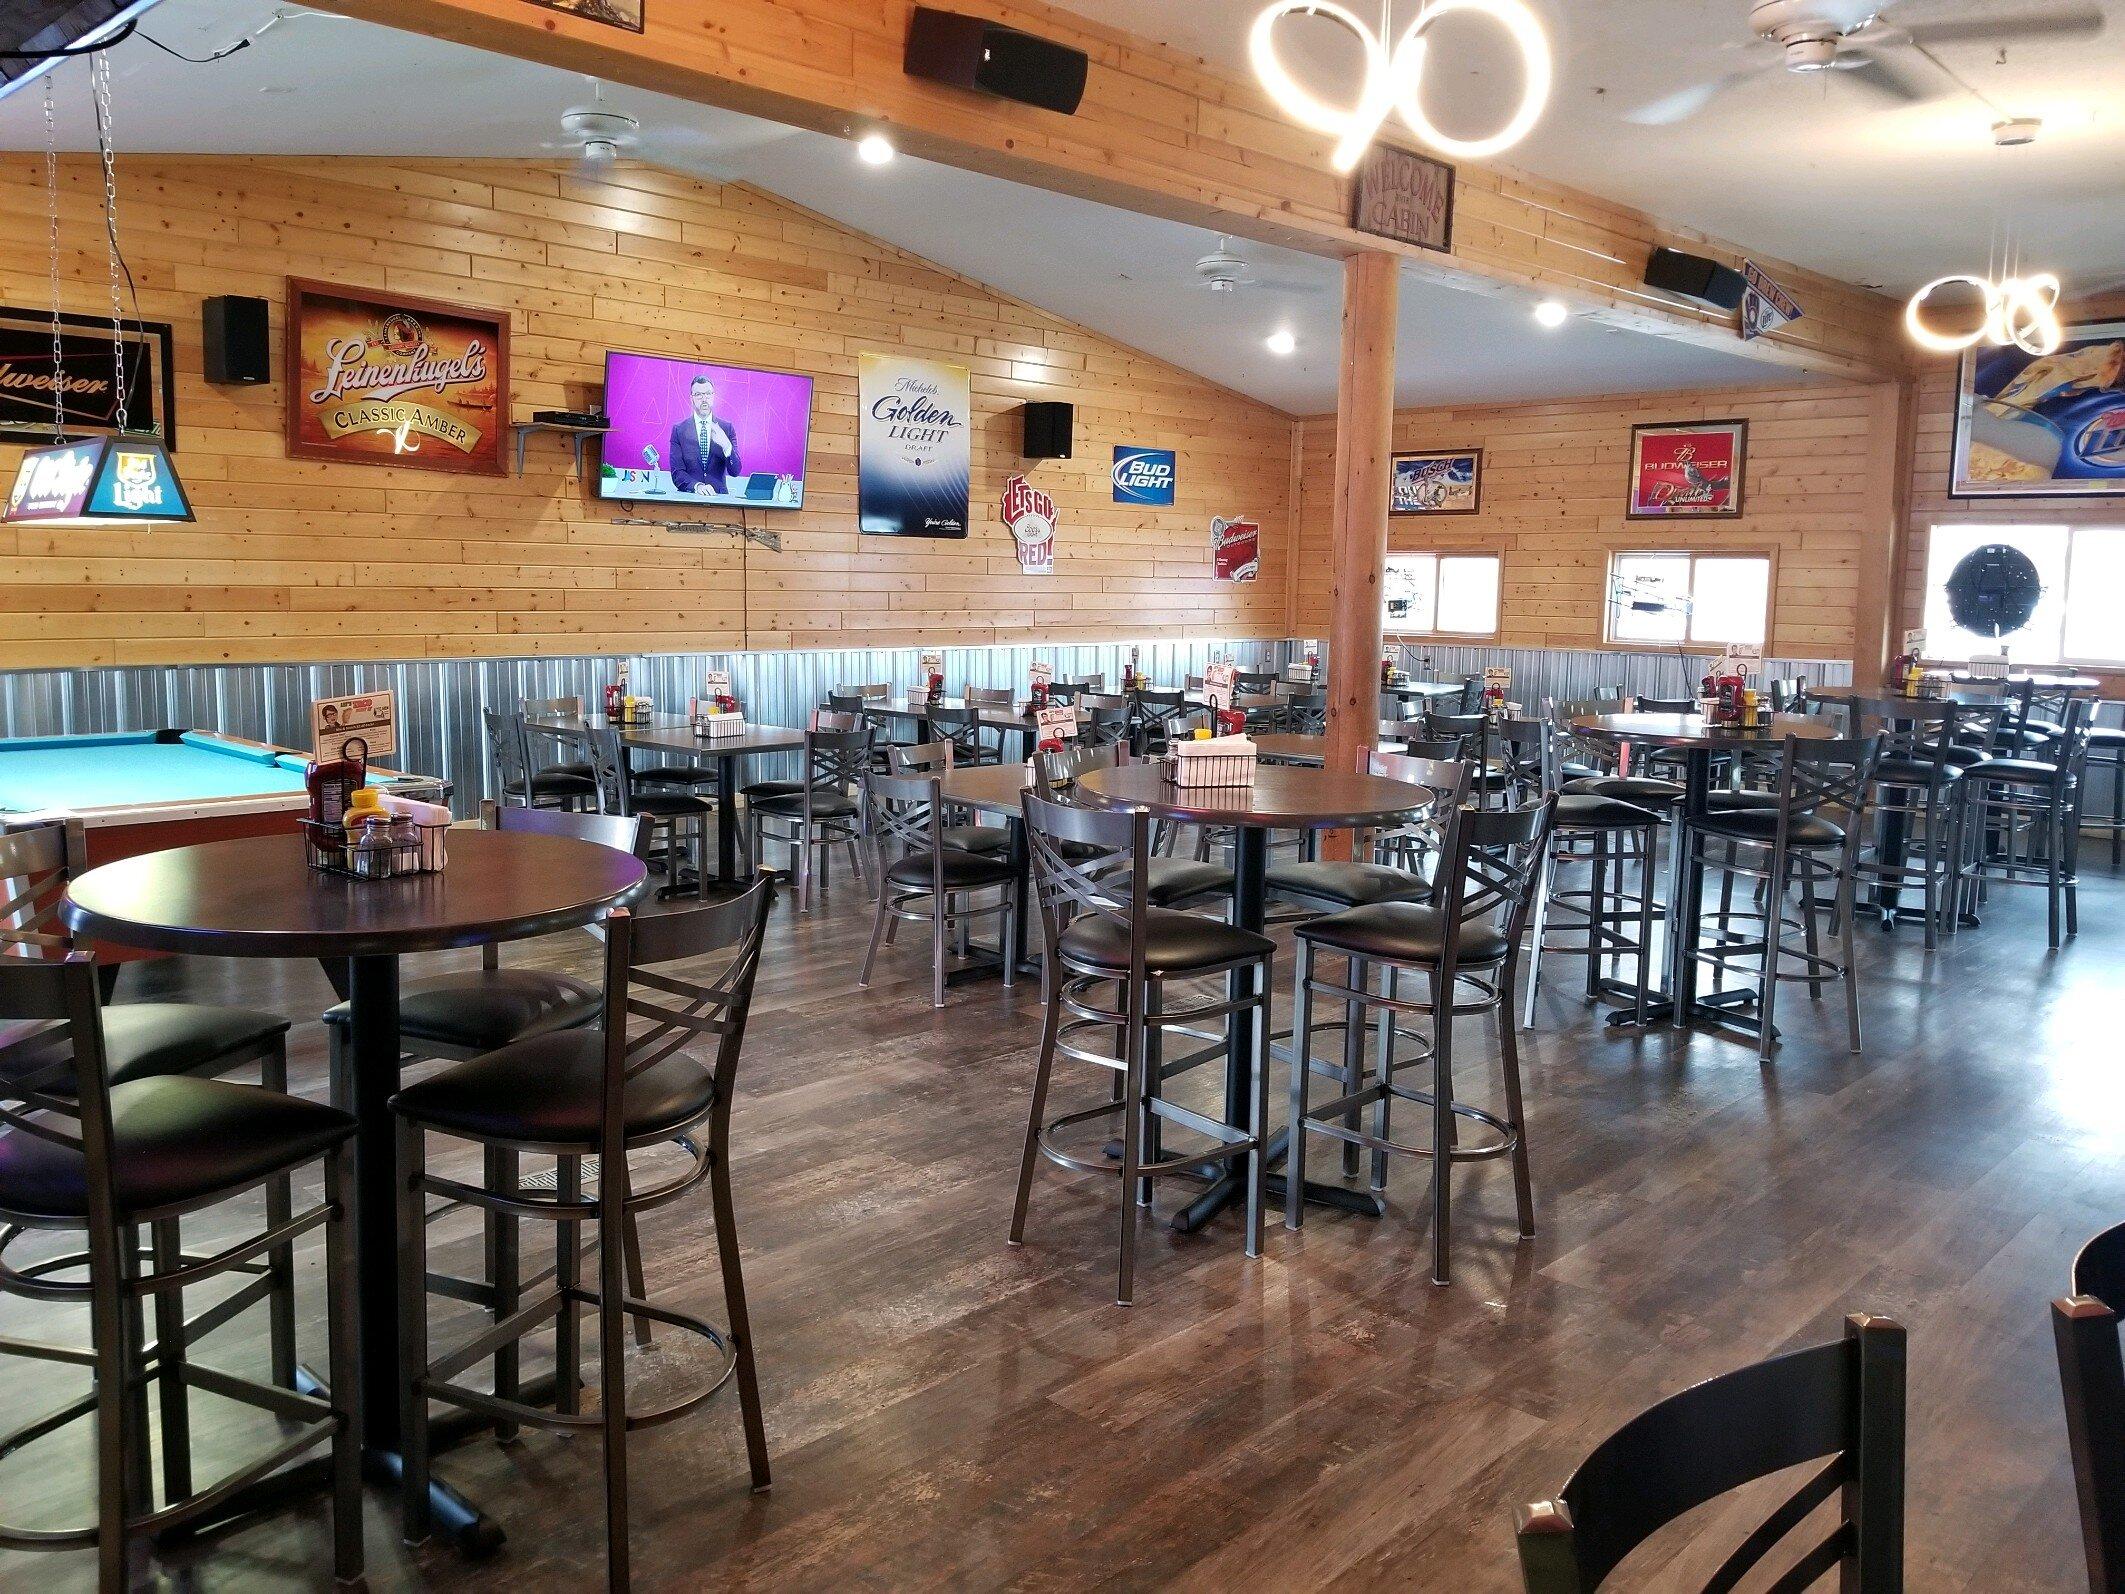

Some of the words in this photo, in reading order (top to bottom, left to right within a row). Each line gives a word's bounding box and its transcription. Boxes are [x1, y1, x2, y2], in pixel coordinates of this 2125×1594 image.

[1371, 202, 1429, 239] CABIN
[310, 340, 487, 402] Leinenkugel's
[872, 396, 961, 426] Golden
[334, 408, 405, 428] CLASSIC
[411, 409, 467, 444] AMBER
[889, 425, 949, 443] LIGHT
[1119, 473, 1174, 489] LIGHT
[1129, 461, 1170, 476] BUD
[1411, 458, 1455, 483] BUSCH
